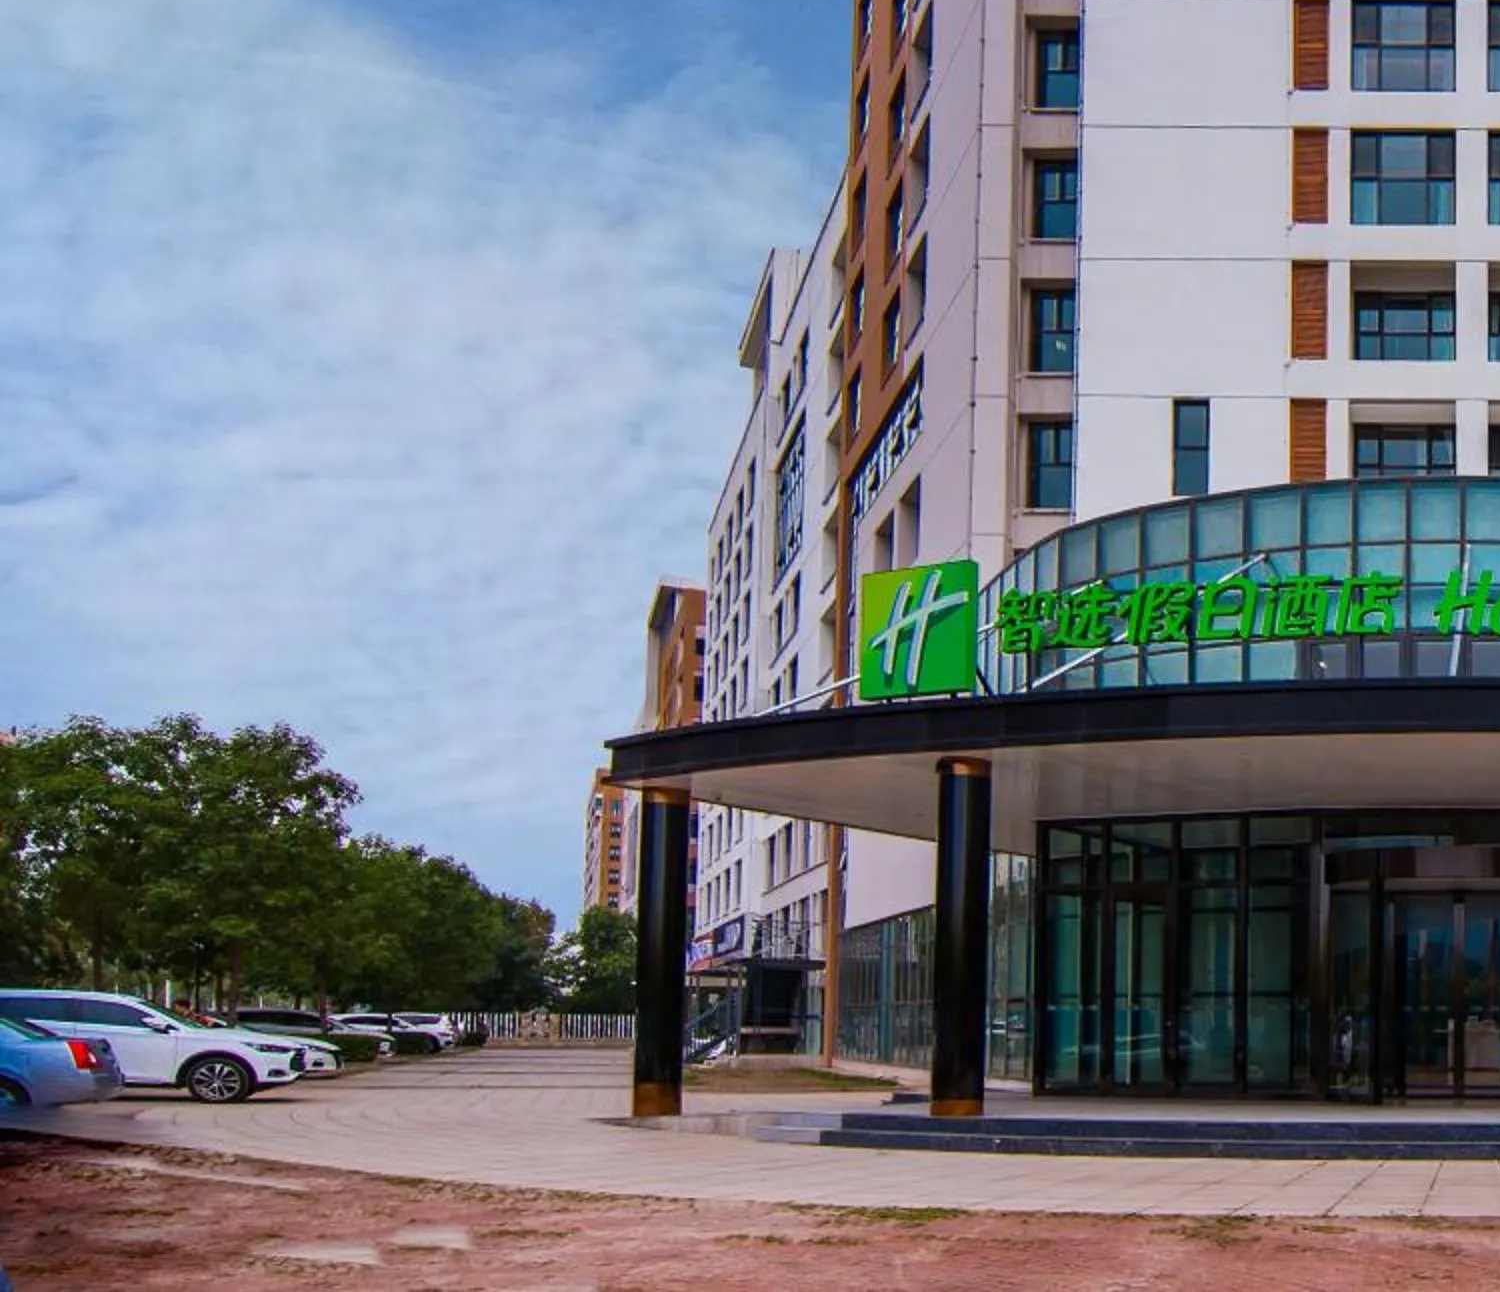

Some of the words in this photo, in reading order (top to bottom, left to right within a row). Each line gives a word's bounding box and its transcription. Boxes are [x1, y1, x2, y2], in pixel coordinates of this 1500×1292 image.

[998, 573, 1402, 654] 智选假日酒店
